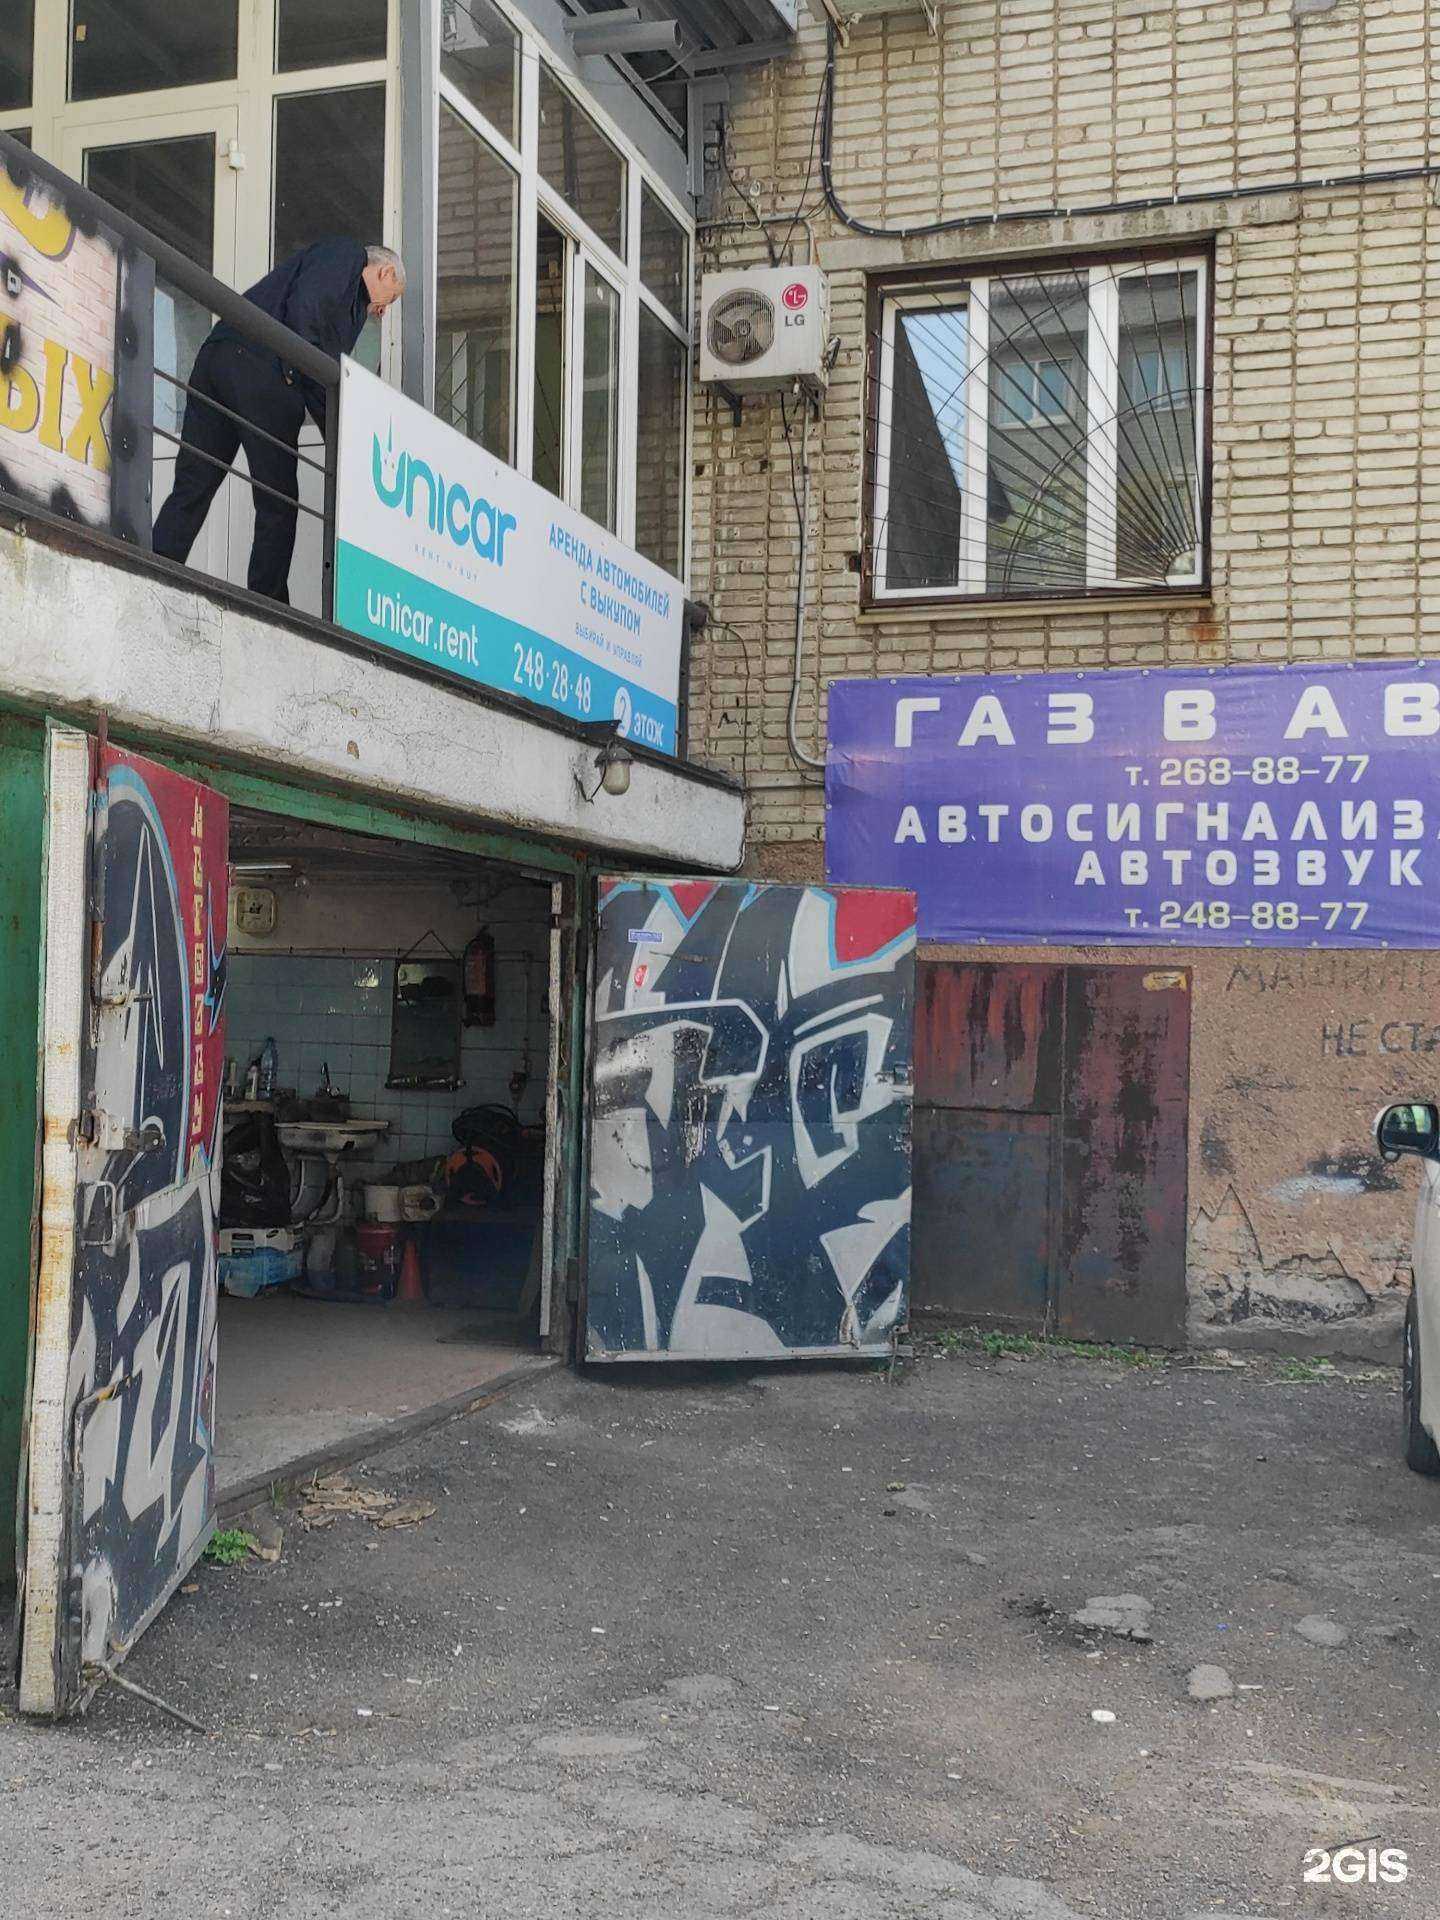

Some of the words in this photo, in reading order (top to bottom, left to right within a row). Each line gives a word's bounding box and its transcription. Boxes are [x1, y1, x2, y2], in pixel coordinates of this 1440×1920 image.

[784, 314, 805, 327] LG
[549, 523, 593, 572] АРЕНДА
[595, 556, 670, 619] АВТОМОБИЛЕЙ
[367, 588, 480, 667] unicar.rent
[590, 586, 641, 636] ВЫКУПОМ
[895, 693, 1095, 748] ГАЗ
[1163, 689, 1217, 741] В
[1160, 755, 1370, 786] 268-88-77
[894, 799, 1440, 844] АВТОСИГНАЛИЗ
[1074, 849, 1424, 886] АВТОЗВУК
[1159, 901, 1370, 930] 248-88-77
